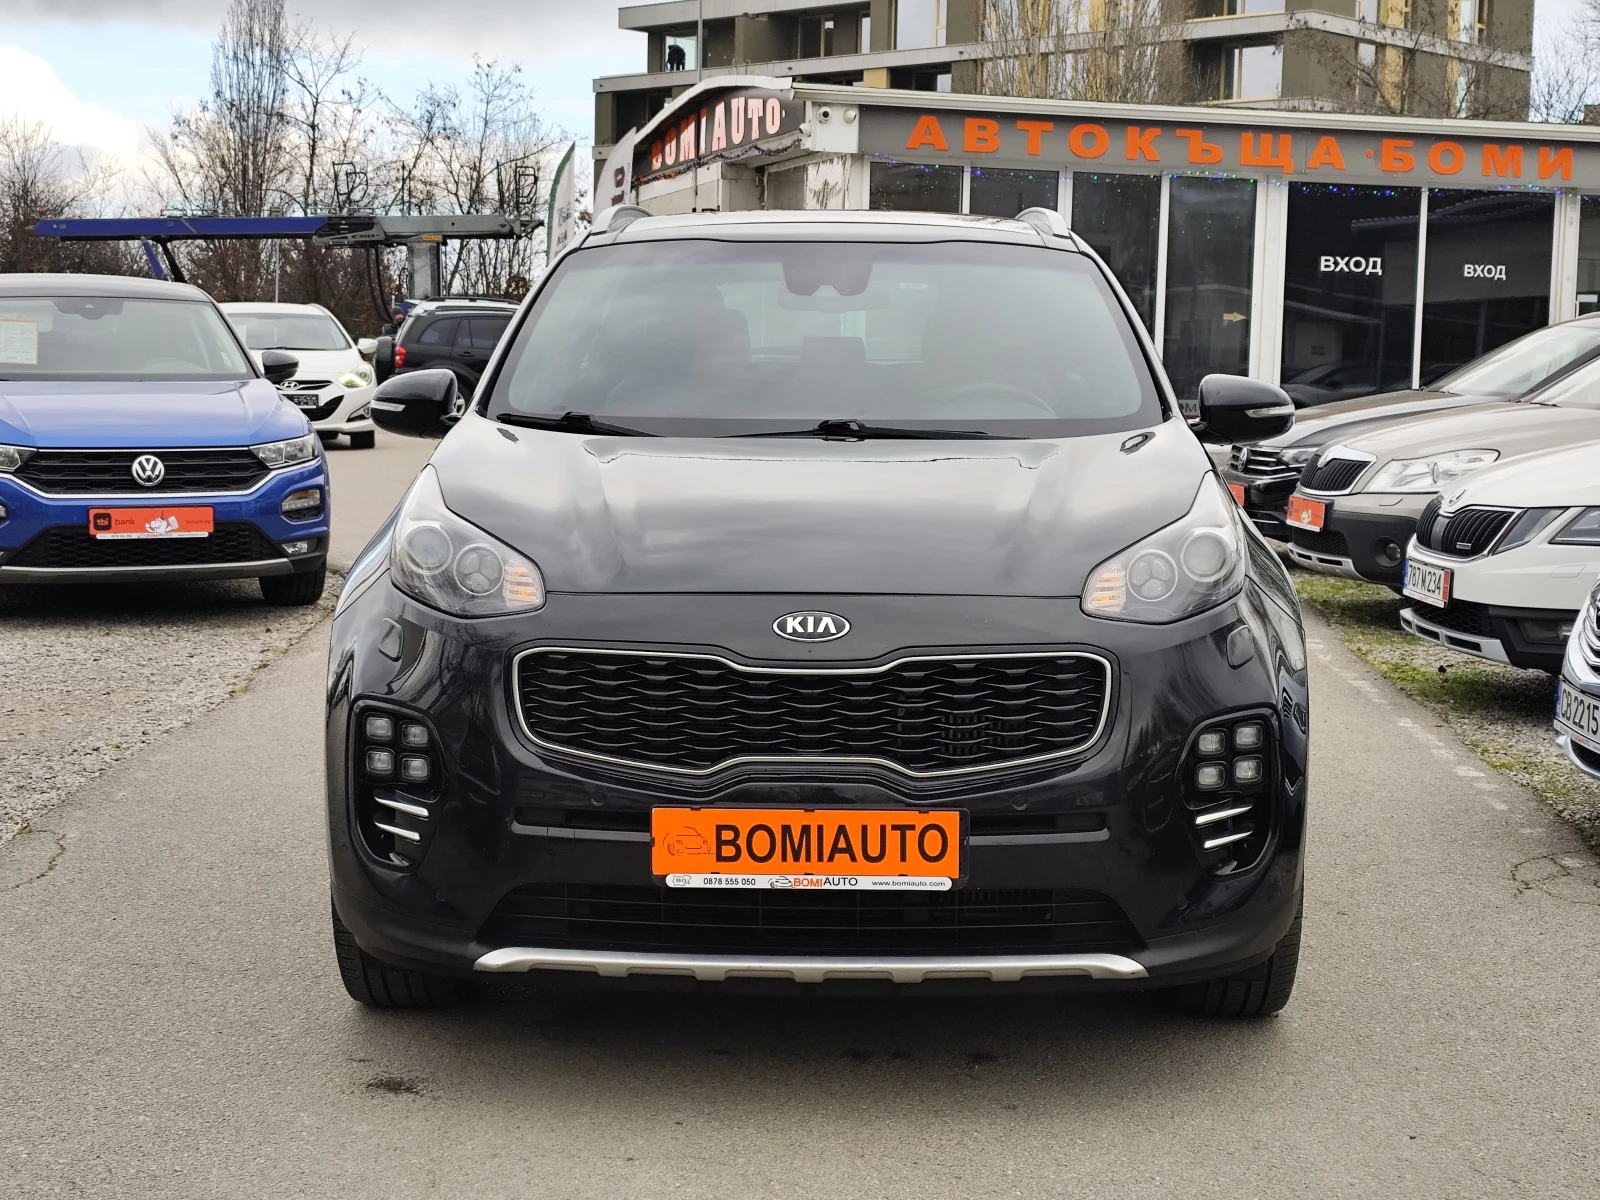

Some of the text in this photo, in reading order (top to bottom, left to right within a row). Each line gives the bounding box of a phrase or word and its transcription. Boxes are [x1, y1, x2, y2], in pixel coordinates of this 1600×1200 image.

[1320, 255, 1382, 275] ВХОД
[1463, 264, 1506, 280] ВХОД
[96, 517, 136, 526] tbi bank
[785, 616, 838, 634] KIA
[715, 823, 949, 863] BOMIAUTO
[703, 877, 756, 886] 0878 555 050
